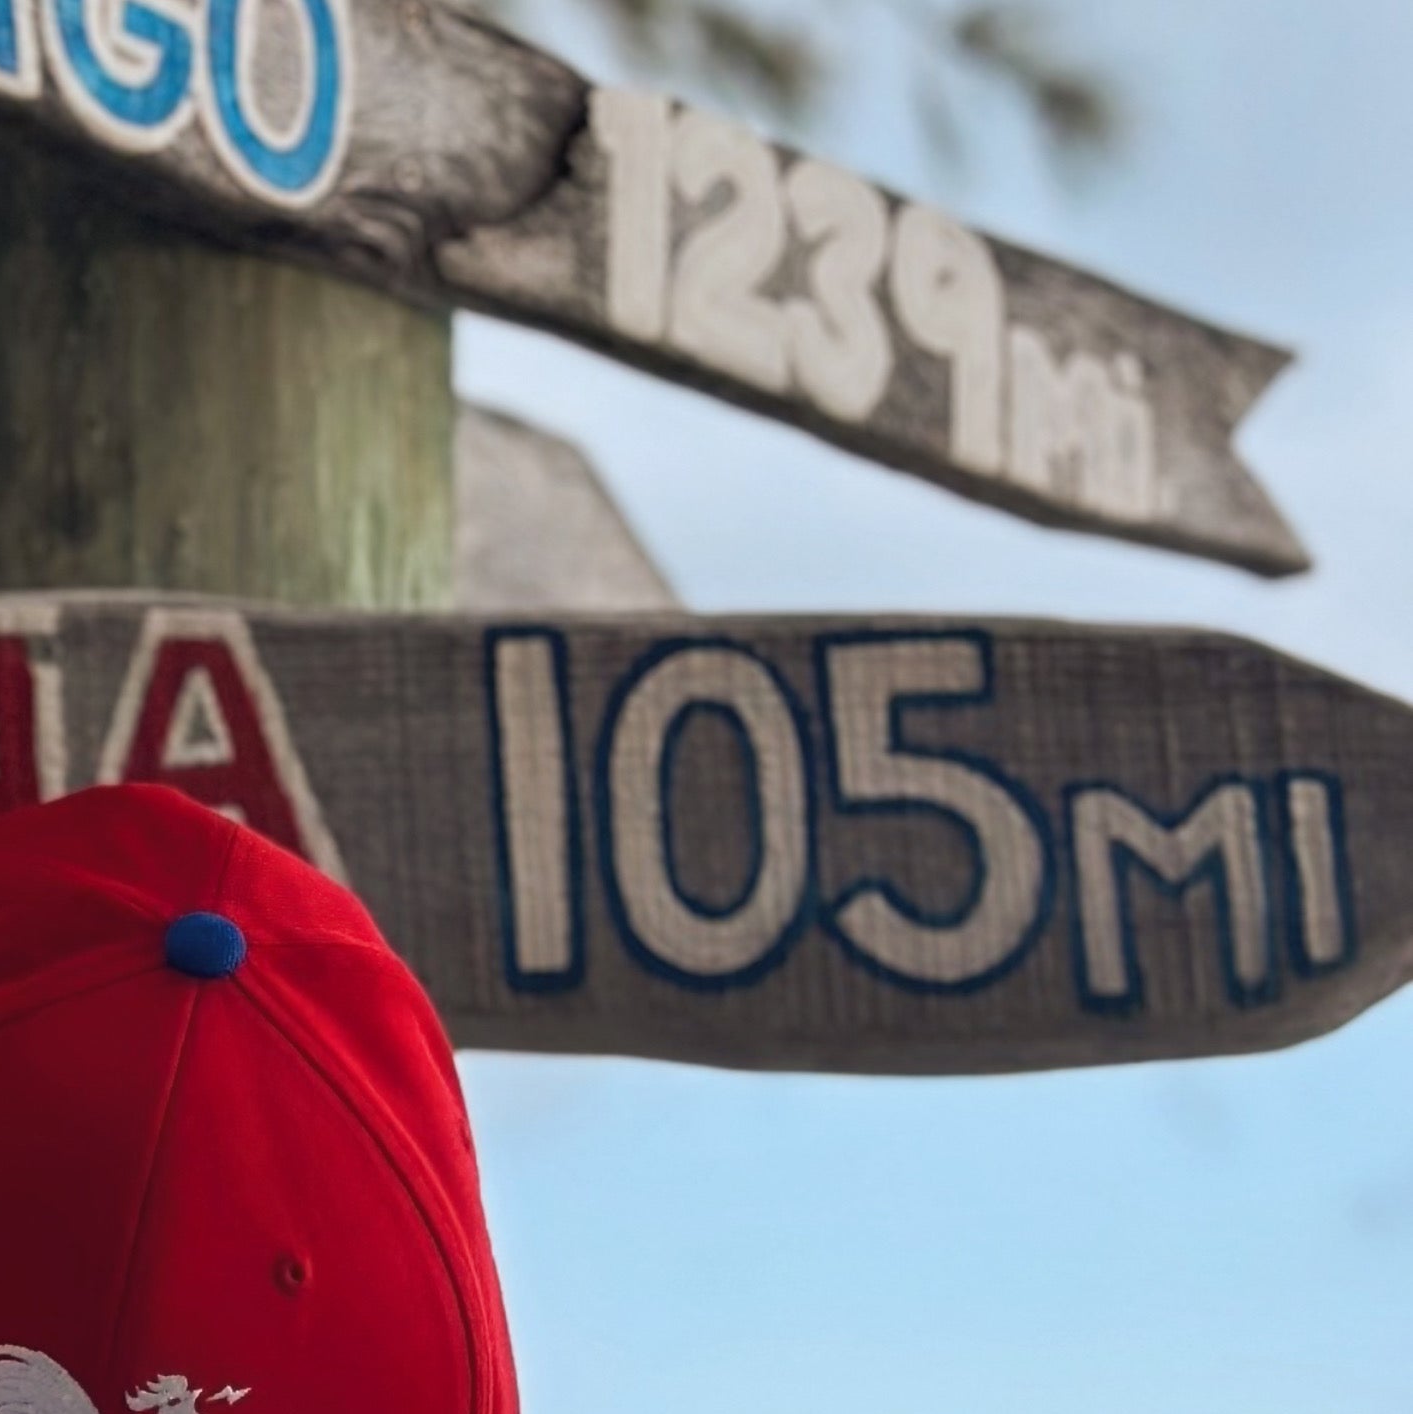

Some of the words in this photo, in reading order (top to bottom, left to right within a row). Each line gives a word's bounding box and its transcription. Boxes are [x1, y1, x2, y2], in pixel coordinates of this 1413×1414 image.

[589, 83, 1006, 480] 1239
[484, 626, 1058, 992] 105
[1062, 770, 1358, 1014] MI
